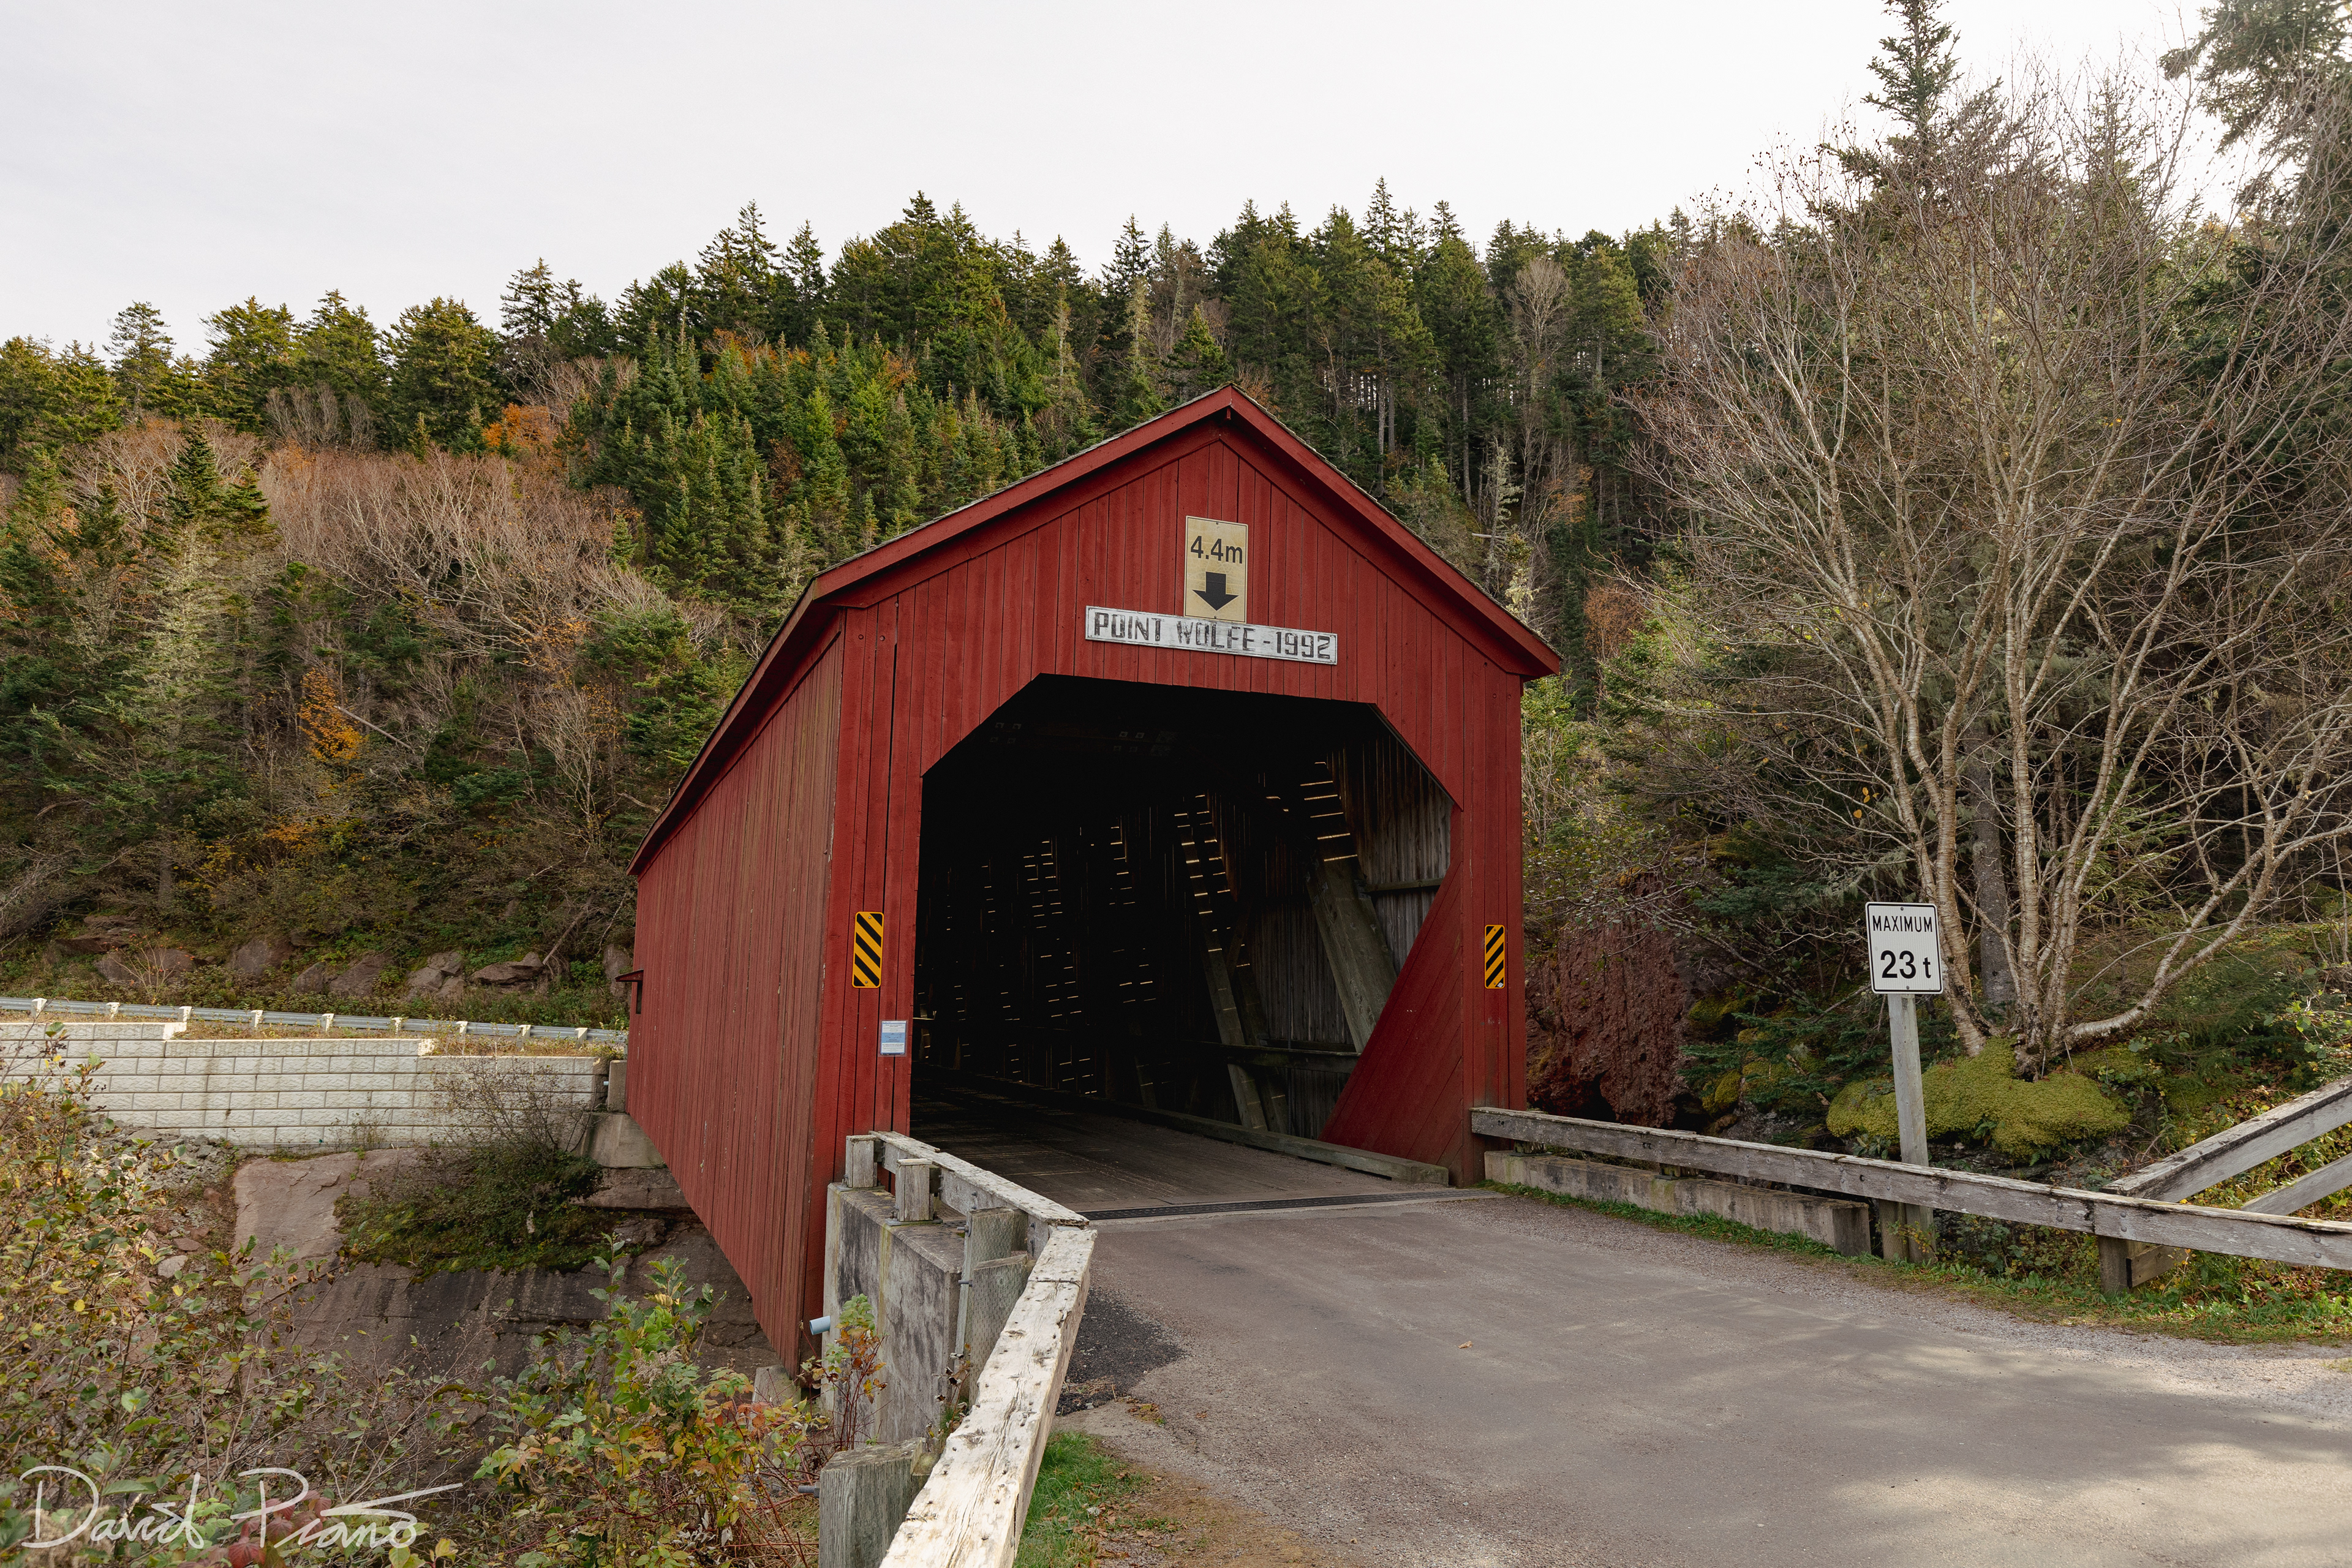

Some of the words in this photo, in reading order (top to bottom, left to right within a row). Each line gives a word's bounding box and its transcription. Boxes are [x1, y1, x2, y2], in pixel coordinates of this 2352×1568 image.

[1190, 535, 1243, 564] 4.4m
[1094, 612, 1164, 642] POINT
[1872, 915, 1933, 933] MAXIMUM
[1880, 950, 1917, 979] 23
[1922, 957, 1932, 979] t
